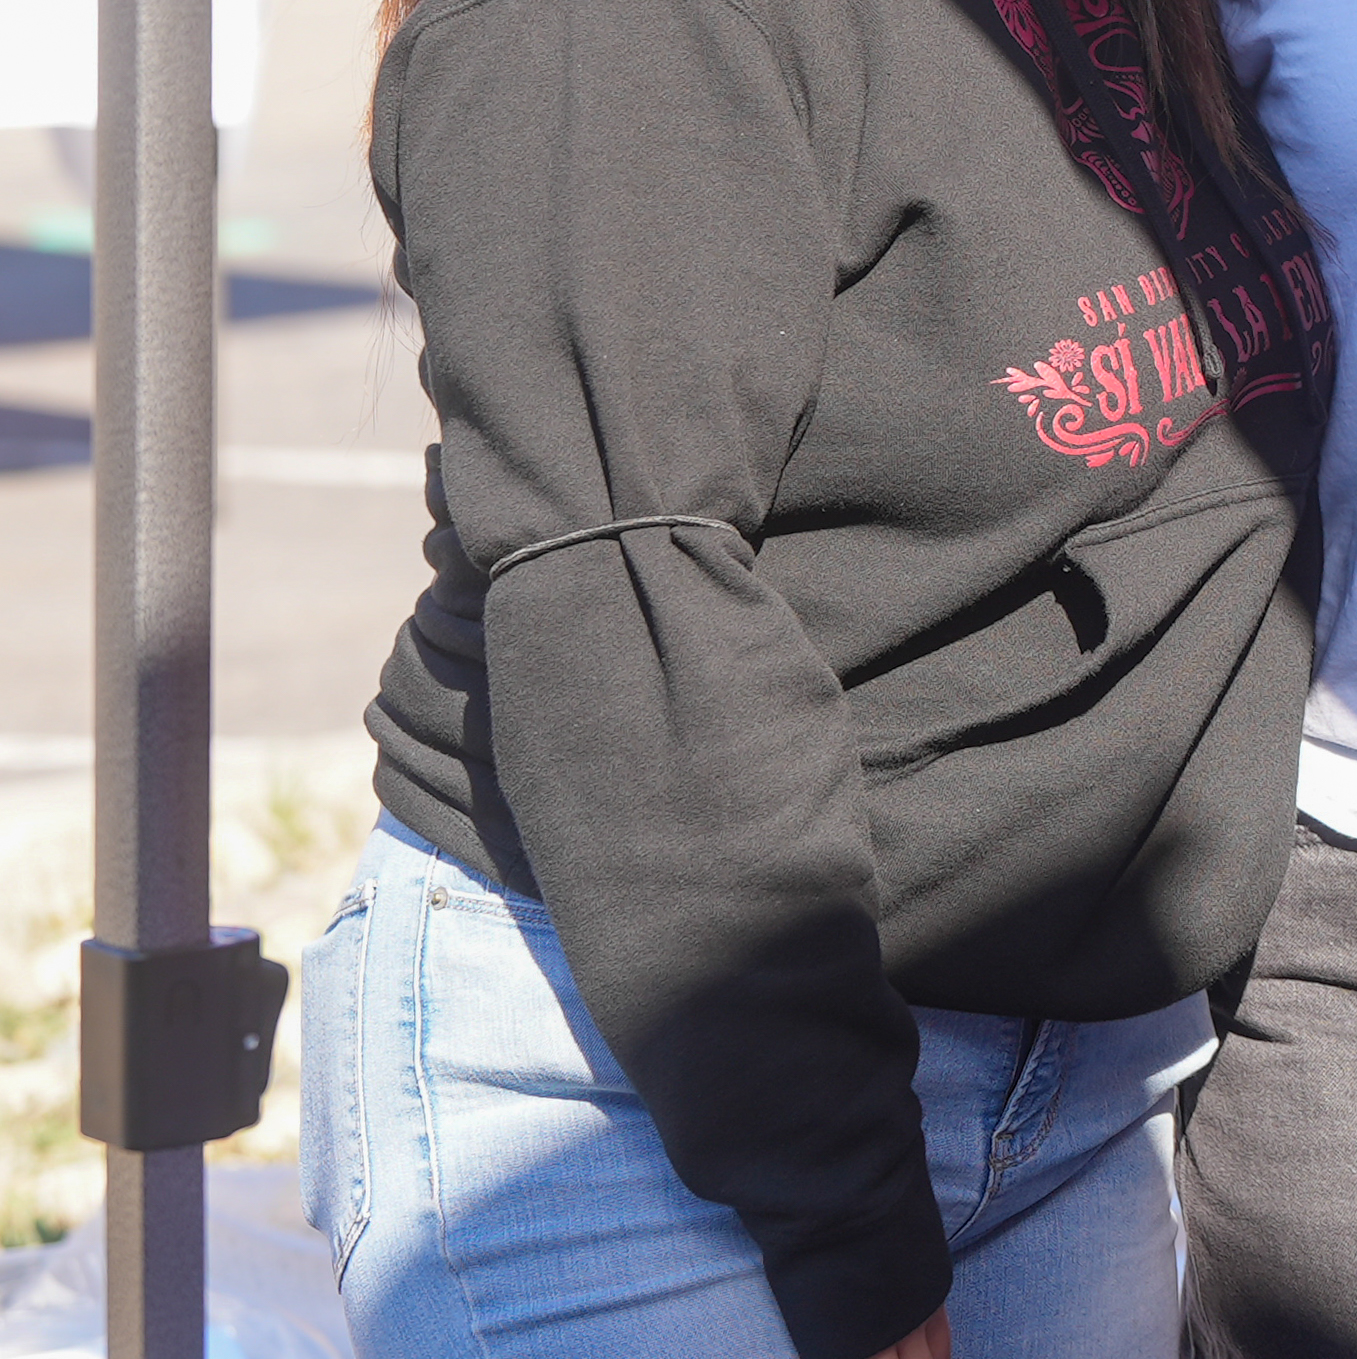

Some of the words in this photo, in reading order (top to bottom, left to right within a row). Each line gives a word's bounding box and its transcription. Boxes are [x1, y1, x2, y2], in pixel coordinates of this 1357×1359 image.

[1077, 284, 1135, 327] SAN
[1185, 245, 1229, 284] ITY
[1090, 321, 1144, 422] SÍ
[1143, 313, 1207, 403] VAL
[1207, 284, 1273, 364] LA
